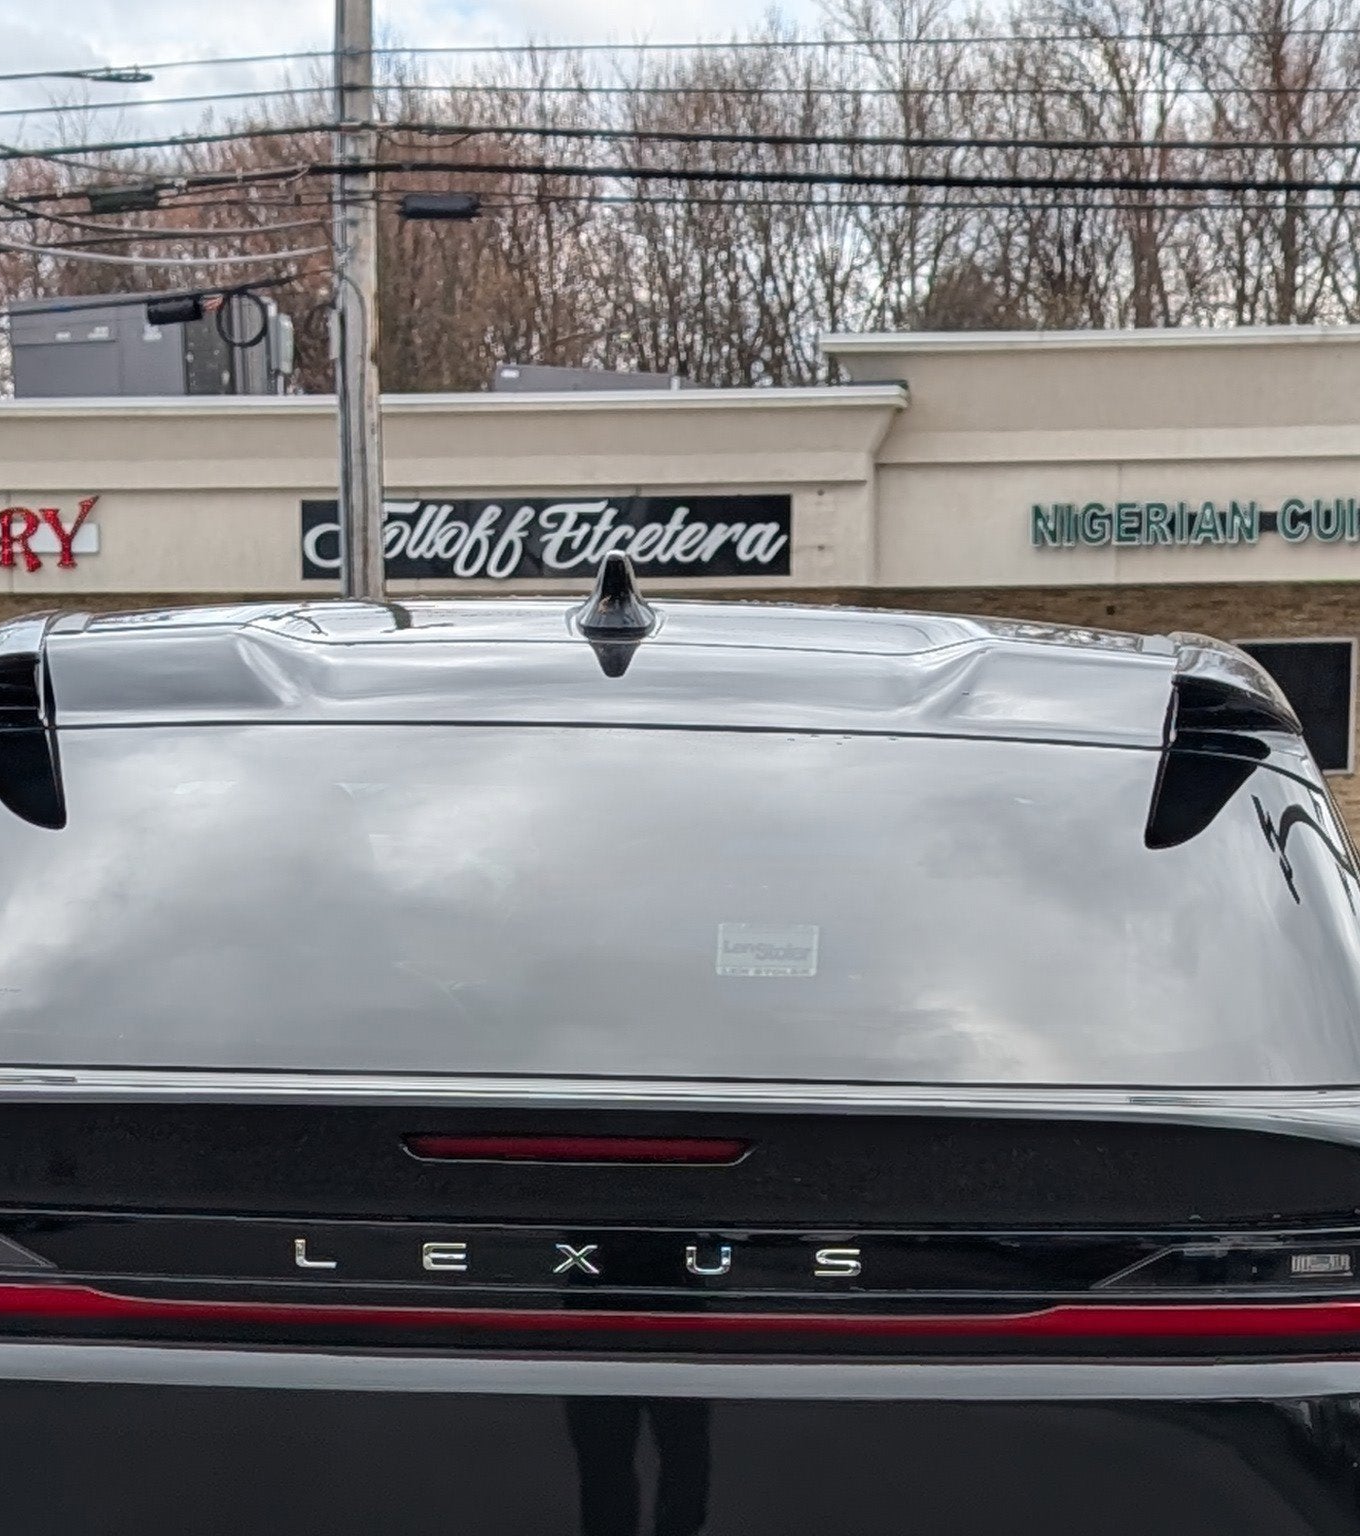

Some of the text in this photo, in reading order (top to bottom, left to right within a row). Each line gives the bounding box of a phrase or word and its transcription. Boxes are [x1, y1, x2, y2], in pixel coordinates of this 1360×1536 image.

[538, 500, 789, 569] Etcetera
[1029, 499, 1260, 548] NIGERIAN
[293, 1237, 863, 1278] LEXUS
